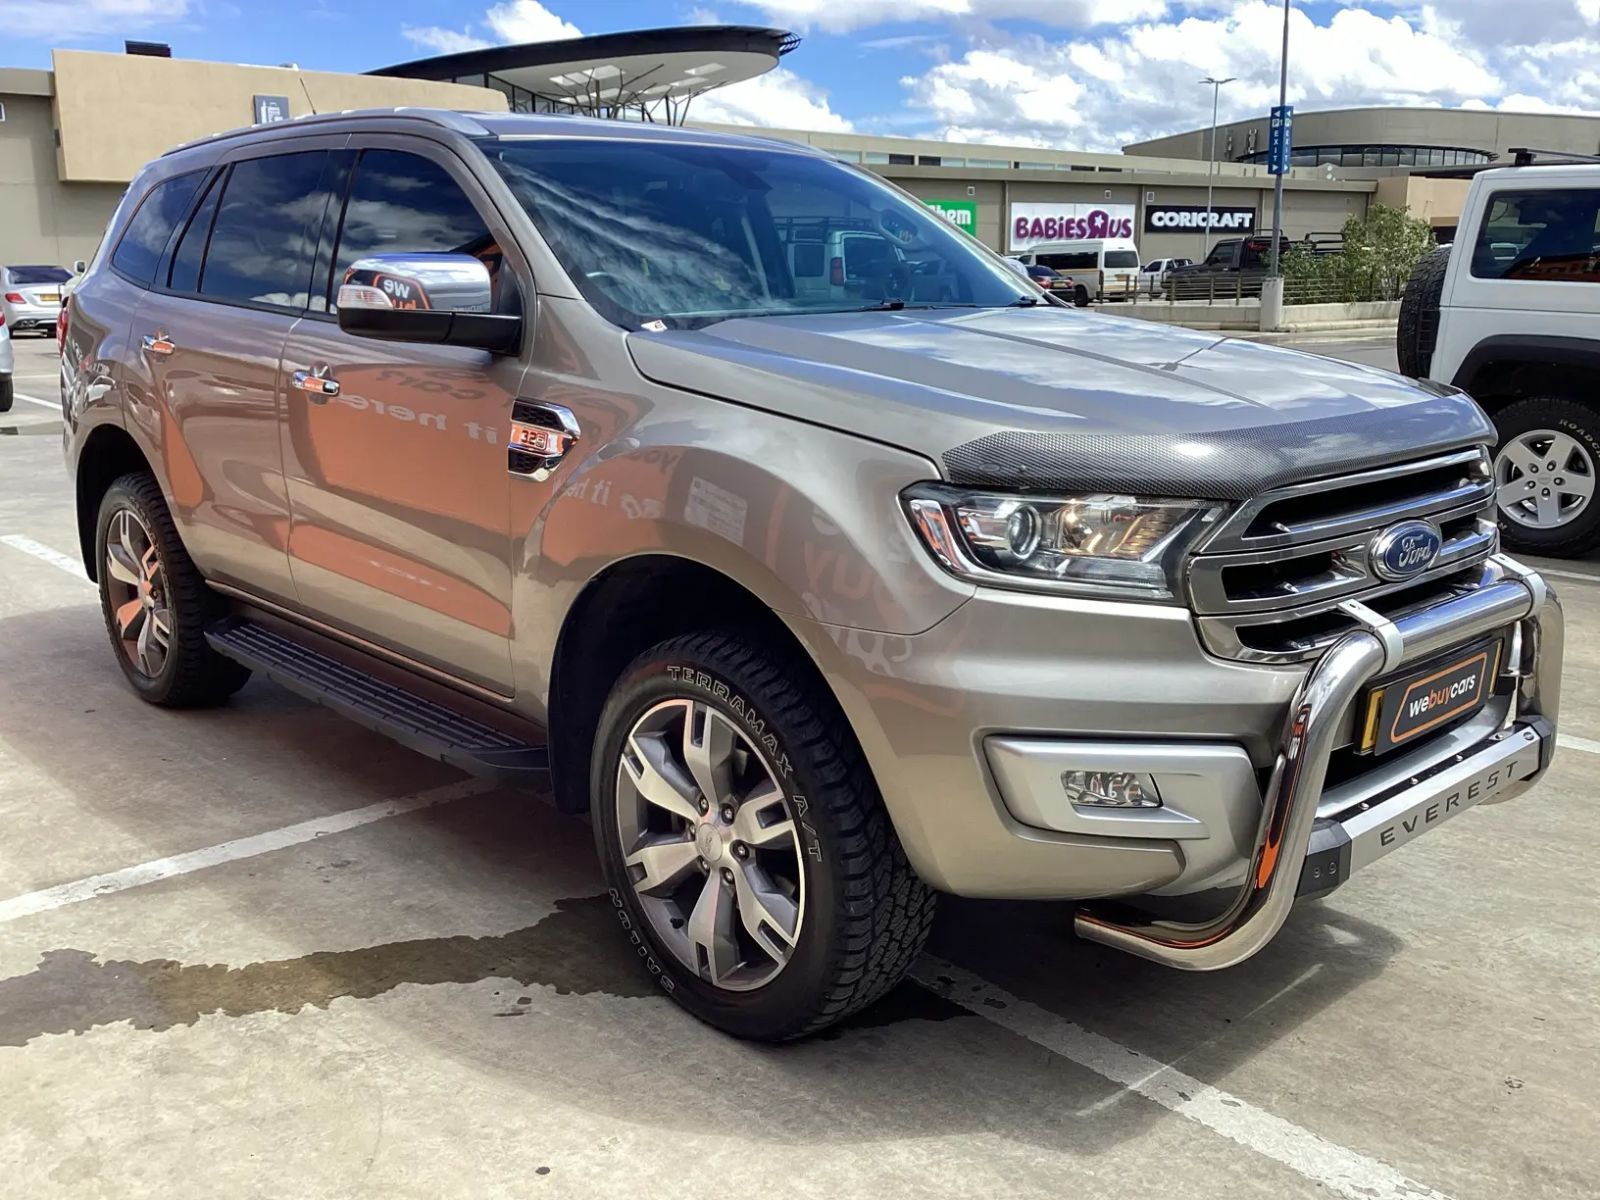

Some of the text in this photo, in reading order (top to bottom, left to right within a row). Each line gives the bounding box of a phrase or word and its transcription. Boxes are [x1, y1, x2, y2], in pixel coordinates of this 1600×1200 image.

[1151, 211, 1253, 228] CORICRAFT
[1558, 418, 1600, 458] ROADC
[1399, 534, 1432, 568] Ford
[1410, 674, 1476, 718] webuycars
[667, 666, 822, 862] TERRAMAX A/T
[1380, 761, 1518, 846] EVEREST
[608, 888, 675, 993] SAILUN
